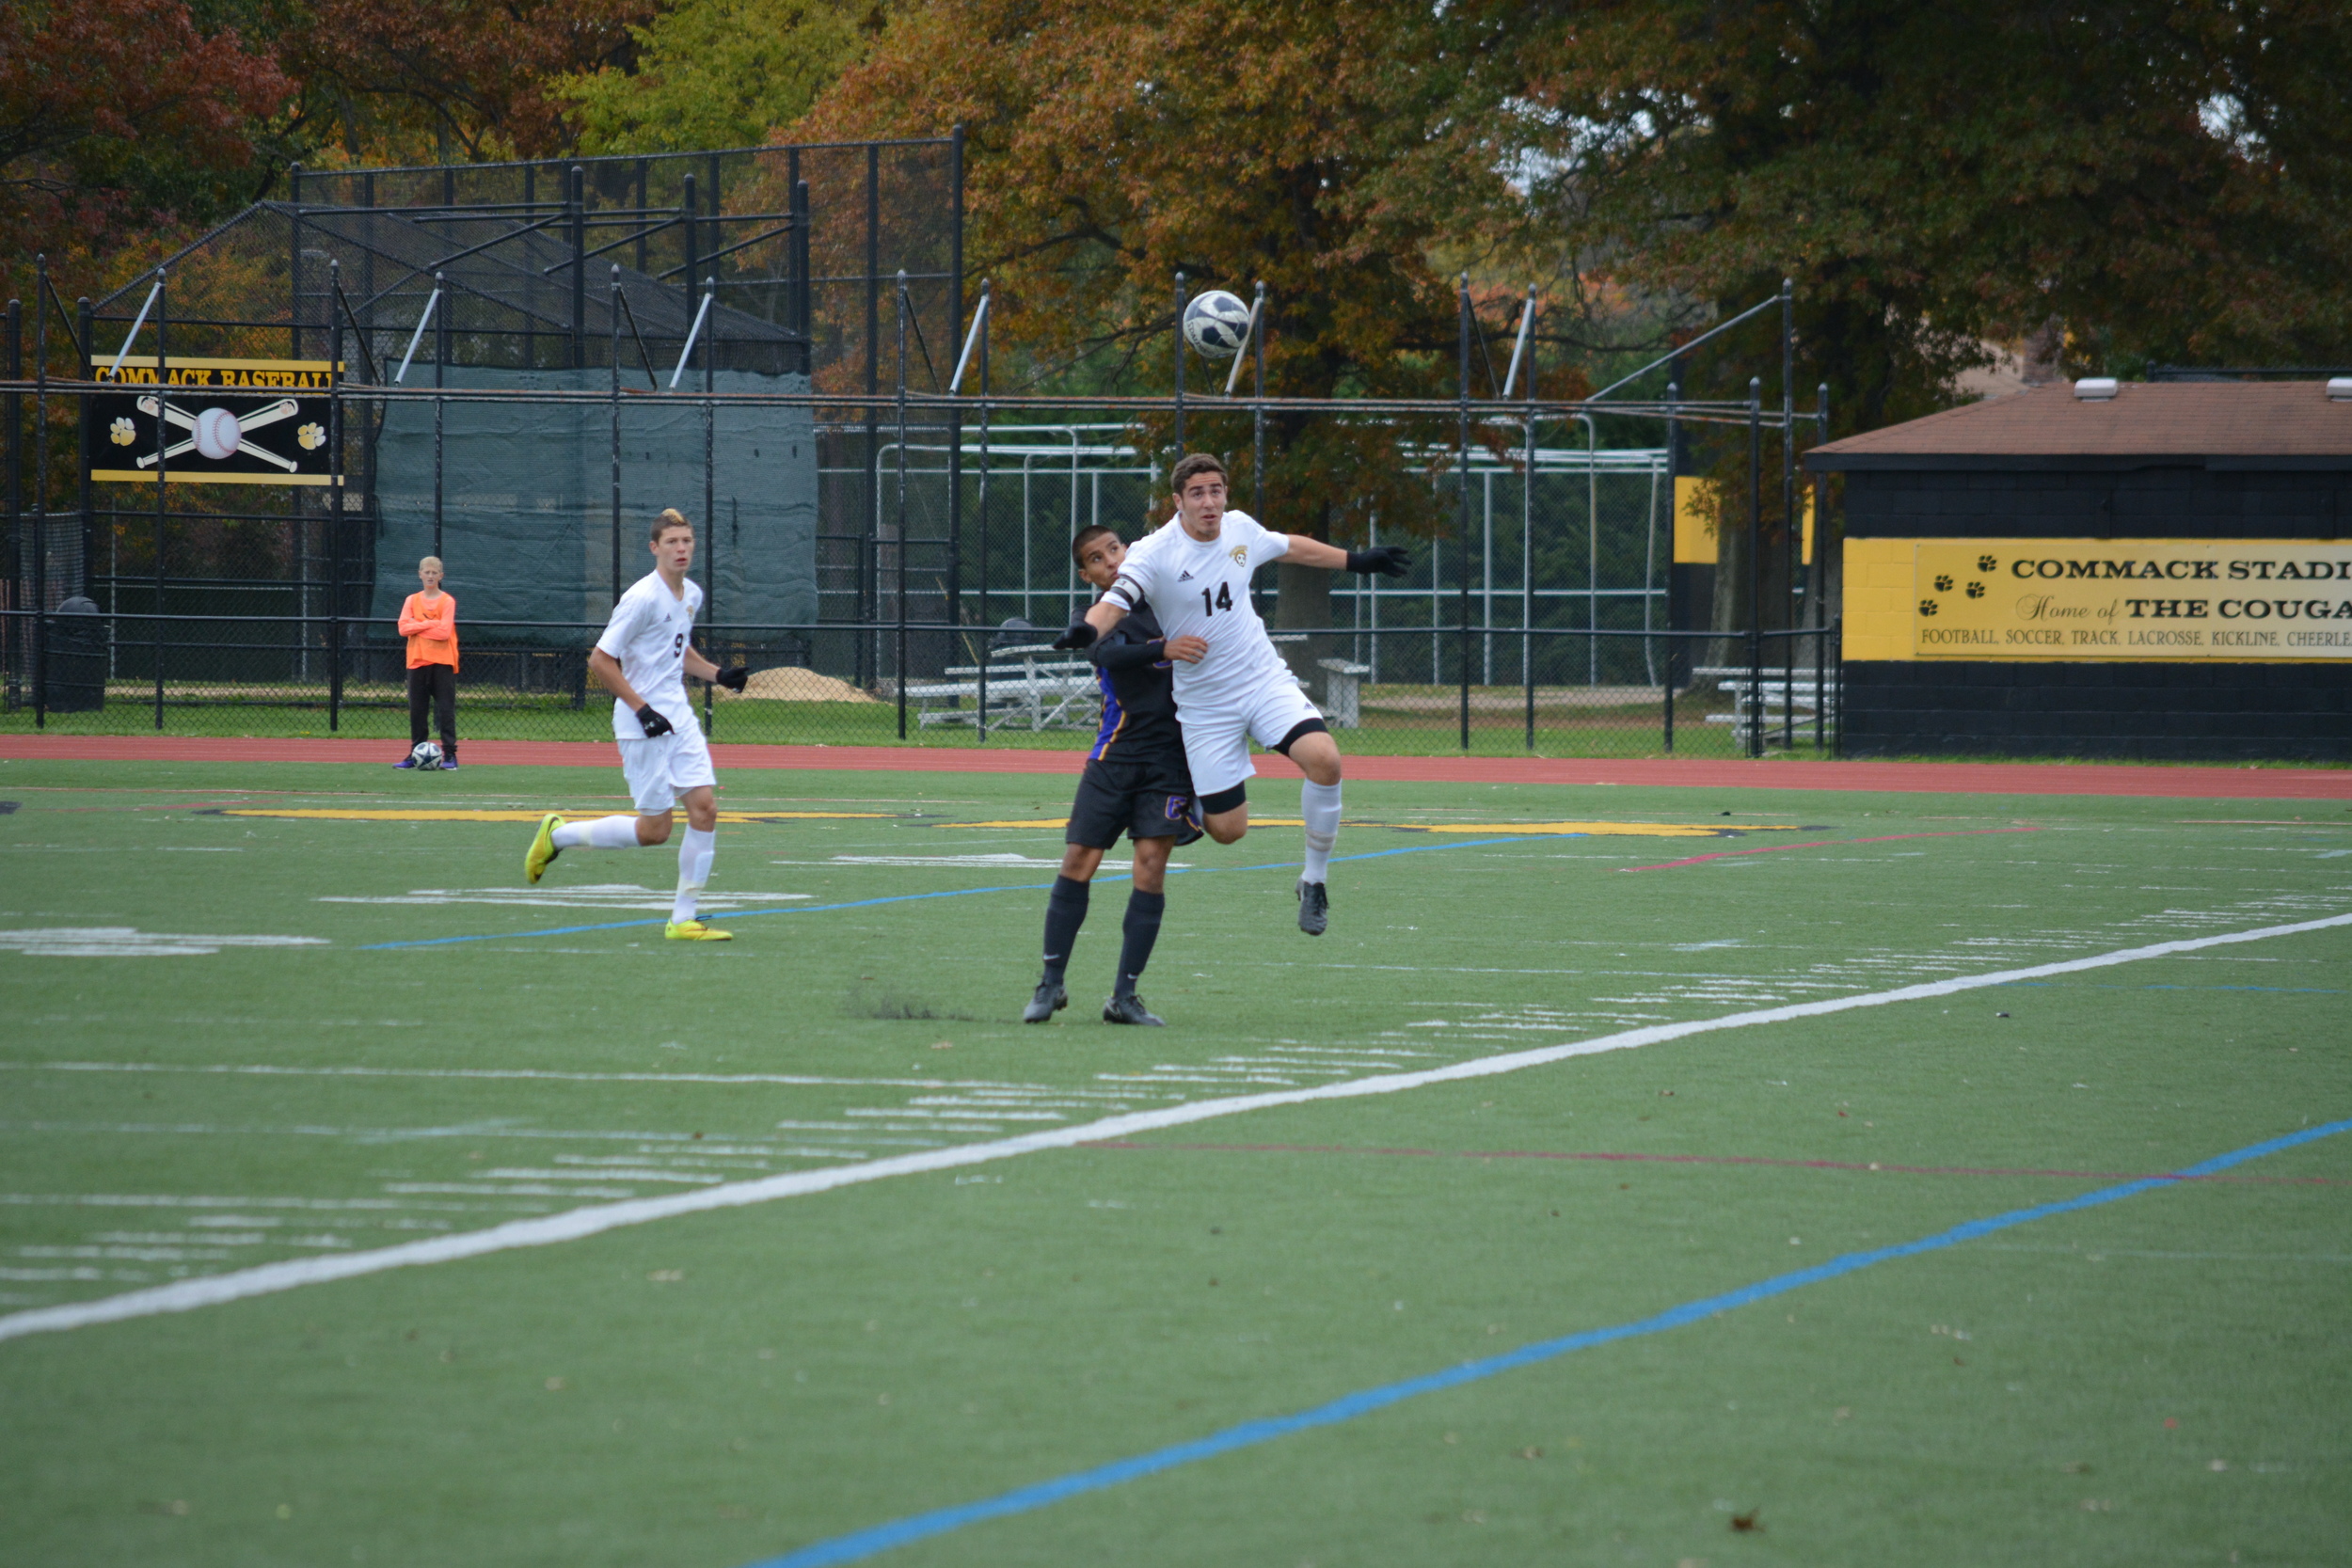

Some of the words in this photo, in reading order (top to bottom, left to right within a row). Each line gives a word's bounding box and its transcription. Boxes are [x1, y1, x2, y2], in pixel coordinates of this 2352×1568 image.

[2011, 559, 2218, 579] COMMACK
[2228, 561, 2351, 579] STADI
[1201, 581, 1232, 616] 14
[2015, 594, 2090, 622] Home
[2097, 598, 2120, 625] of
[2125, 599, 2208, 618] THE
[2217, 599, 2352, 619] COUGA
[674, 632, 684, 658] 9
[2287, 632, 2352, 646] CHEERLE
